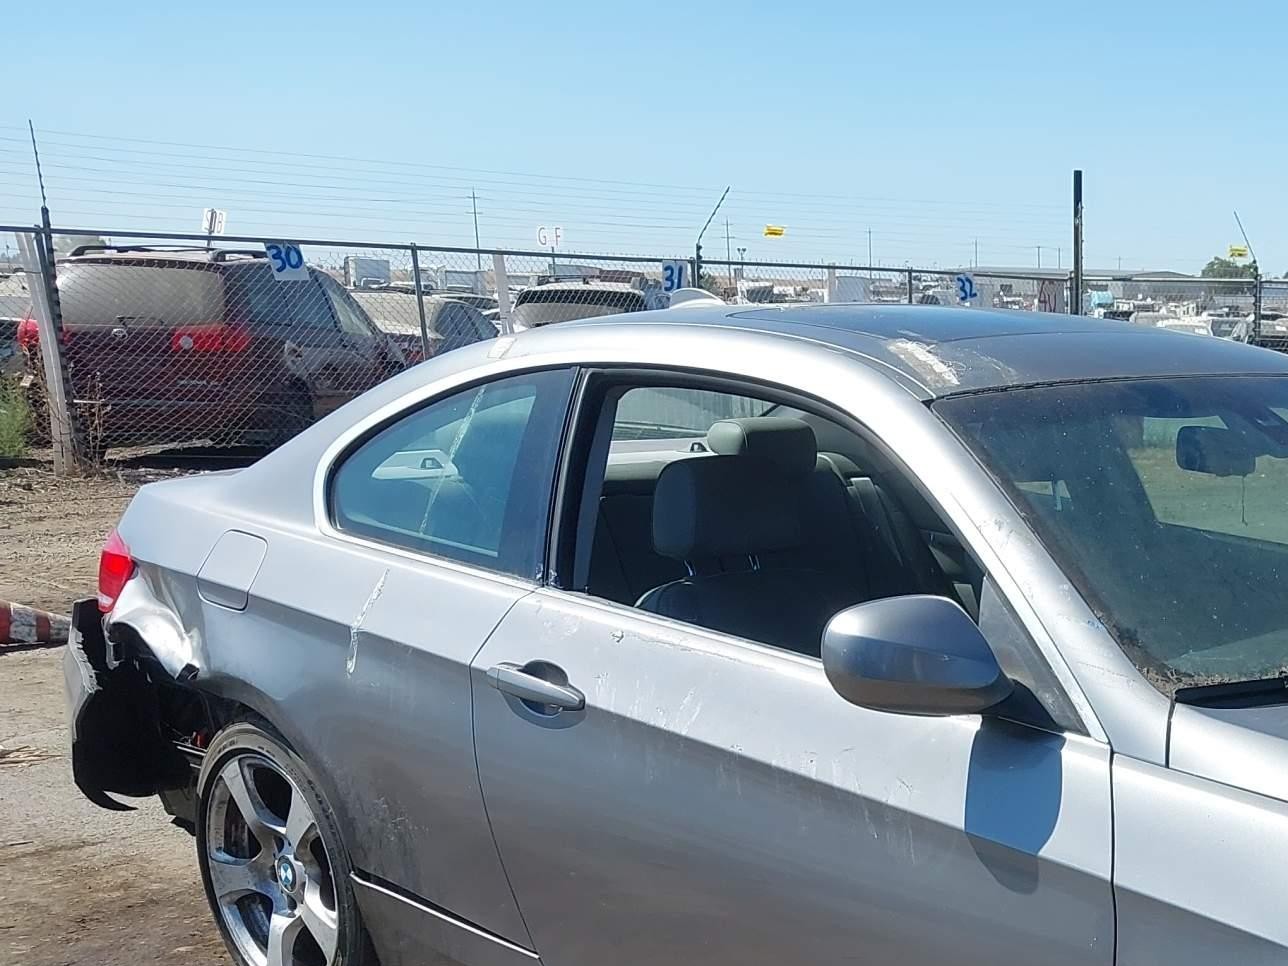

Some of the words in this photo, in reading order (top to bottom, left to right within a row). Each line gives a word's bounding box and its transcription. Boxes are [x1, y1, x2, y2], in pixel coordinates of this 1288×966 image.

[538, 226, 547, 246] G
[555, 226, 561, 246] F
[266, 244, 304, 273] 30
[663, 264, 684, 292] 31
[957, 276, 978, 301] 32
